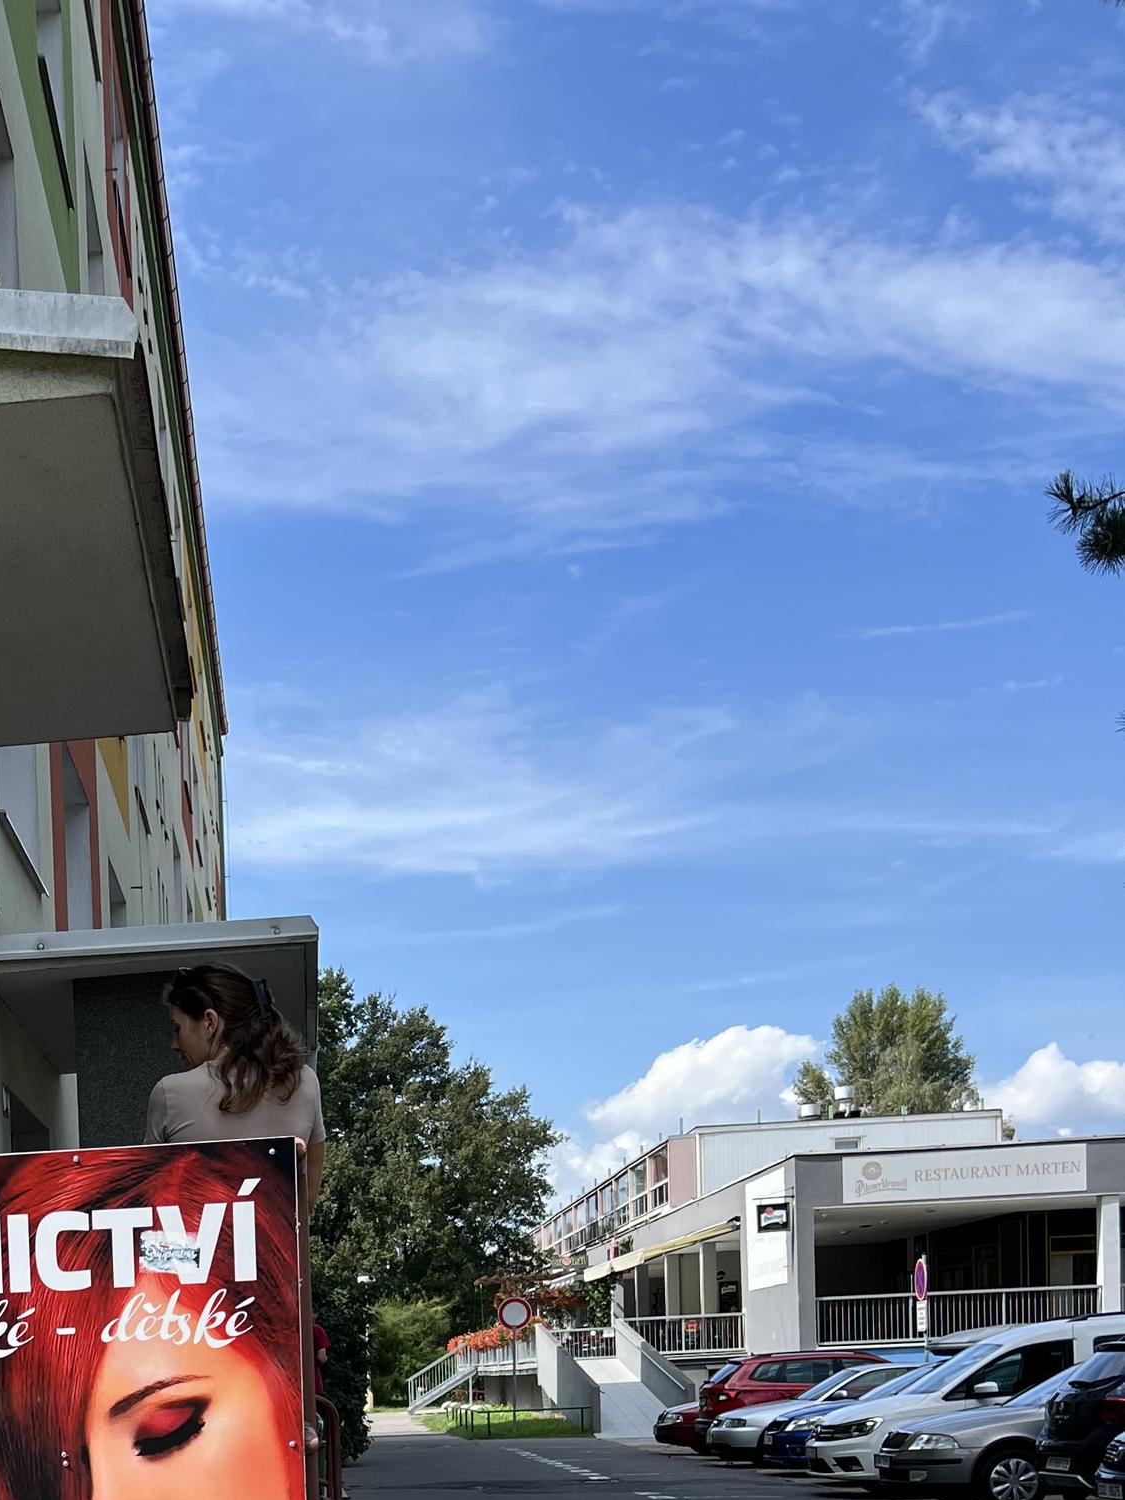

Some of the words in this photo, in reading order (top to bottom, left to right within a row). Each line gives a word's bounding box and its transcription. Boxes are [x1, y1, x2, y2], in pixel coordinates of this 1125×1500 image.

[914, 1164, 1011, 1182] RESTAURANT
[1016, 1161, 1081, 1177] MARTEN
[100, 1290, 255, 1349] dětské
